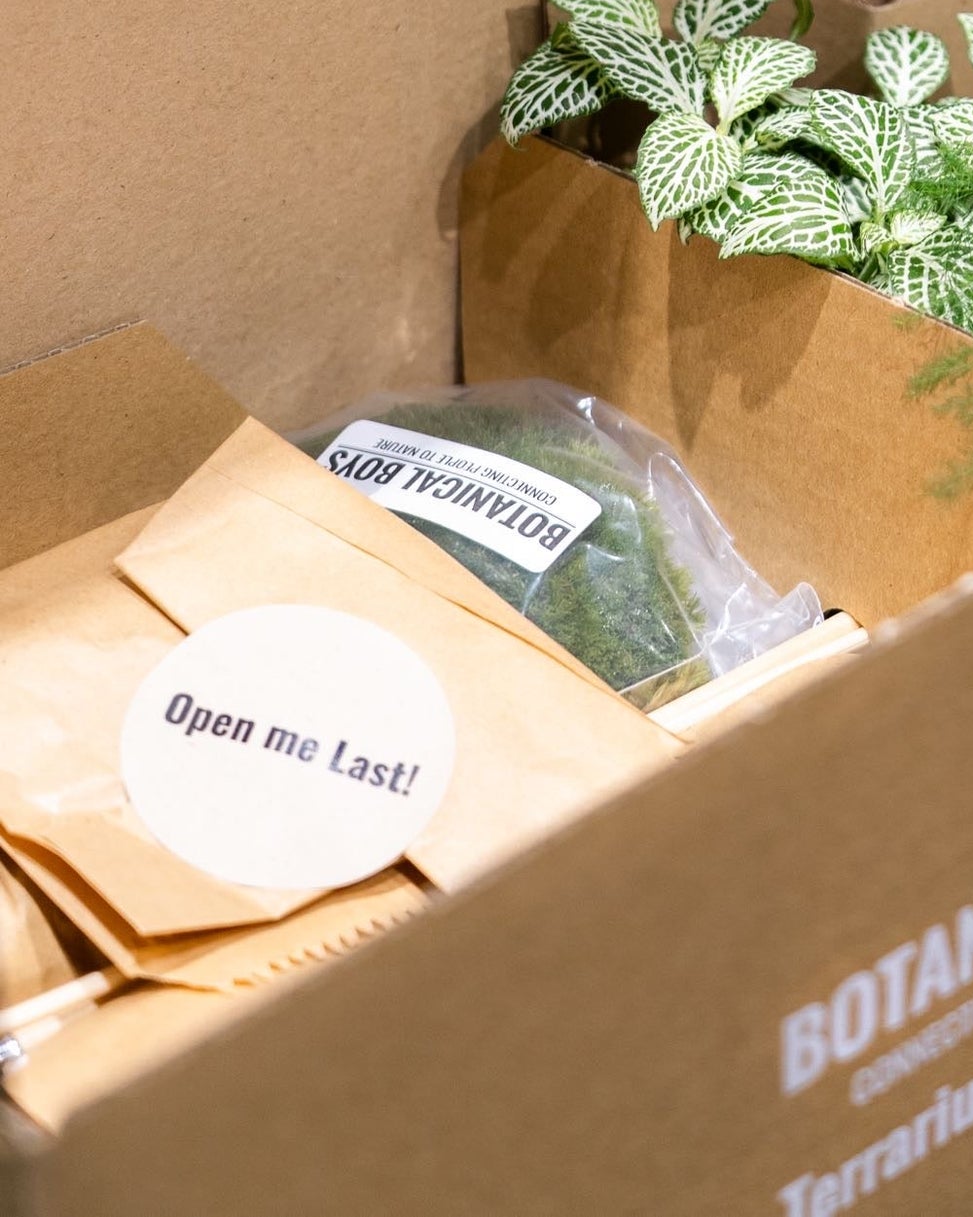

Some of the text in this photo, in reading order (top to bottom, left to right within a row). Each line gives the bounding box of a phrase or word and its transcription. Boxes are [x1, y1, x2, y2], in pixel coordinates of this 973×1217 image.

[326, 449, 571, 551] BOTANICAL BOYS
[373, 438, 557, 506] CONNECTING PEOPLE TO NATURE
[164, 693, 420, 796] Open me Last!
